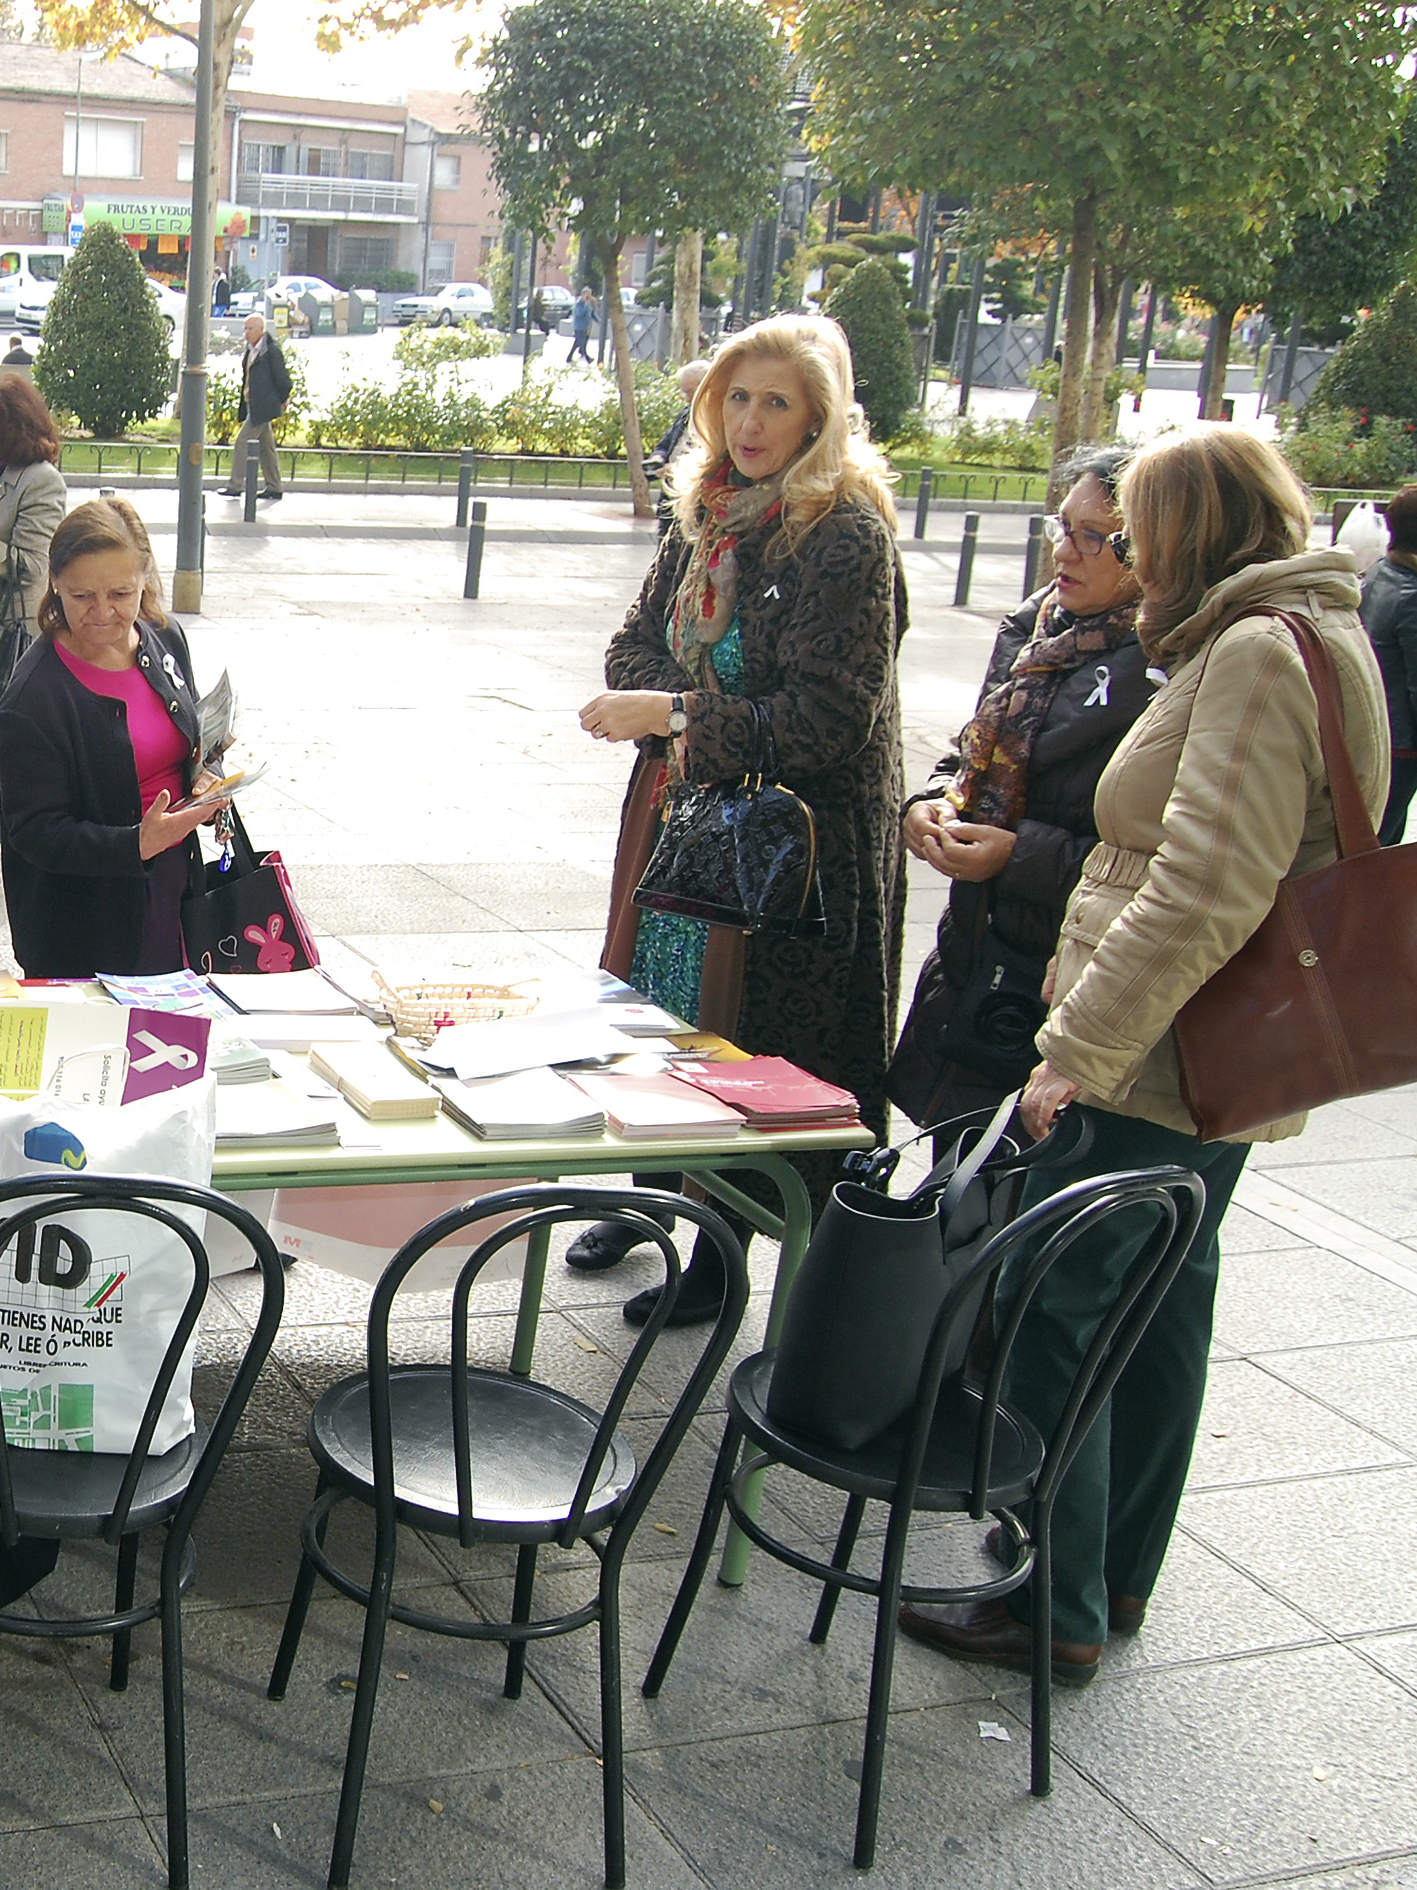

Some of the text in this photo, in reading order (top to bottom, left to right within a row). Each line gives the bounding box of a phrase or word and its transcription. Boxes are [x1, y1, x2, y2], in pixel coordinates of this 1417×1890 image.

[106, 203, 147, 215] FRUTAS
[149, 204, 158, 215] Y
[101, 1055, 112, 1087] Solicita
[0, 1308, 47, 1331] TIENES
[51, 1315, 91, 1335] NAD
[91, 1306, 123, 1325] QUE
[18, 1334, 42, 1354] LEE
[46, 1334, 58, 1356] Ó
